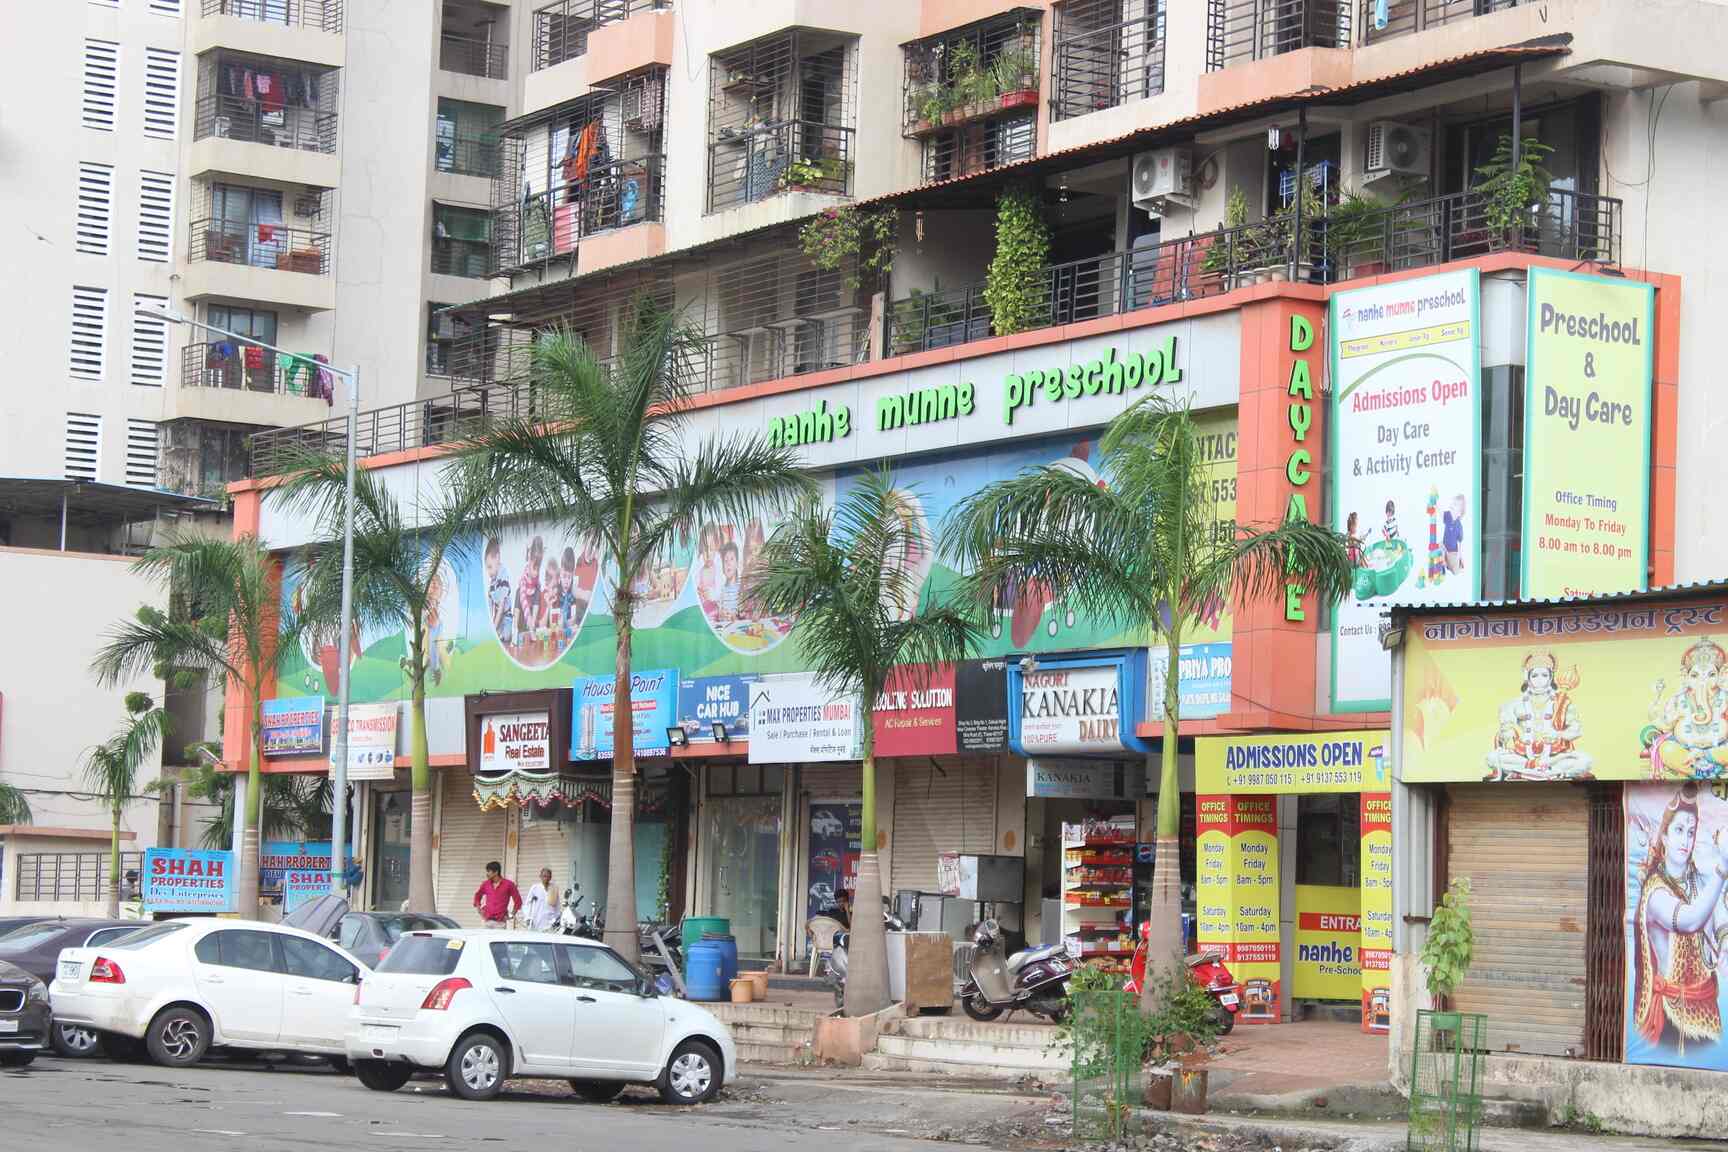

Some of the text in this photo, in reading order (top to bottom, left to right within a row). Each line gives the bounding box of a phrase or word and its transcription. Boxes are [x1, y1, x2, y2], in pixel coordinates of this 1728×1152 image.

[1358, 304, 1384, 322] nanhe
[1417, 288, 1466, 317] preschool
[1540, 303, 1640, 346] Preschool
[1583, 352, 1596, 378] &
[768, 336, 1182, 449] nanhe munne preschool
[1353, 380, 1468, 413] Admissions Open
[1545, 385, 1632, 431] Day Care
[1377, 421, 1430, 447] Day Care
[1353, 448, 1457, 477] & Activity Center
[1555, 490, 1617, 513] Office Timing
[1544, 513, 1627, 537] Monday To Friday
[1538, 536, 1632, 561] 8.00 am to 8.00 pm
[1340, 625, 1363, 637] Contact
[1365, 624, 1373, 634] Us
[1178, 657, 1208, 679] PRIYA
[1024, 672, 1069, 688] NAGORI
[706, 684, 731, 702] NICE
[911, 687, 952, 709] SOLUTION
[697, 701, 739, 719] CAR HUB
[1022, 687, 1119, 718] KANAKIA
[767, 708, 781, 722] MAX
[783, 704, 822, 722] PROPERTIES
[500, 722, 551, 742] SANGEETA
[813, 728, 831, 738] Rental
[838, 728, 852, 737] Loan
[1079, 718, 1118, 741] DAIRY
[505, 745, 521, 760] Real
[1321, 741, 1363, 767] OPEN
[1037, 772, 1091, 784] KANAKIA
[1233, 771, 1362, 786] +91 9987 050 115 +91 9137 553 119
[1201, 802, 1225, 812] OFFICE
[1237, 802, 1271, 812] OFFICE
[1199, 813, 1228, 824] TIMINGS
[1234, 813, 1273, 824] TIMINGS
[1203, 843, 1225, 854] Monday
[1240, 843, 1268, 854] Monday
[1368, 843, 1392, 855] Monday
[152, 858, 224, 876] SHAH
[261, 855, 284, 868] HAH
[1243, 858, 1266, 870] Friday
[1370, 859, 1390, 873] Friday
[151, 877, 224, 888] PROPERTIES
[1236, 874, 1252, 885] 8am
[1258, 874, 1273, 886] 5pm
[1202, 906, 1226, 917] Saturday
[1239, 906, 1271, 917] Saturday
[1261, 922, 1276, 933] 4pm
[1299, 941, 1352, 963] nanhe
